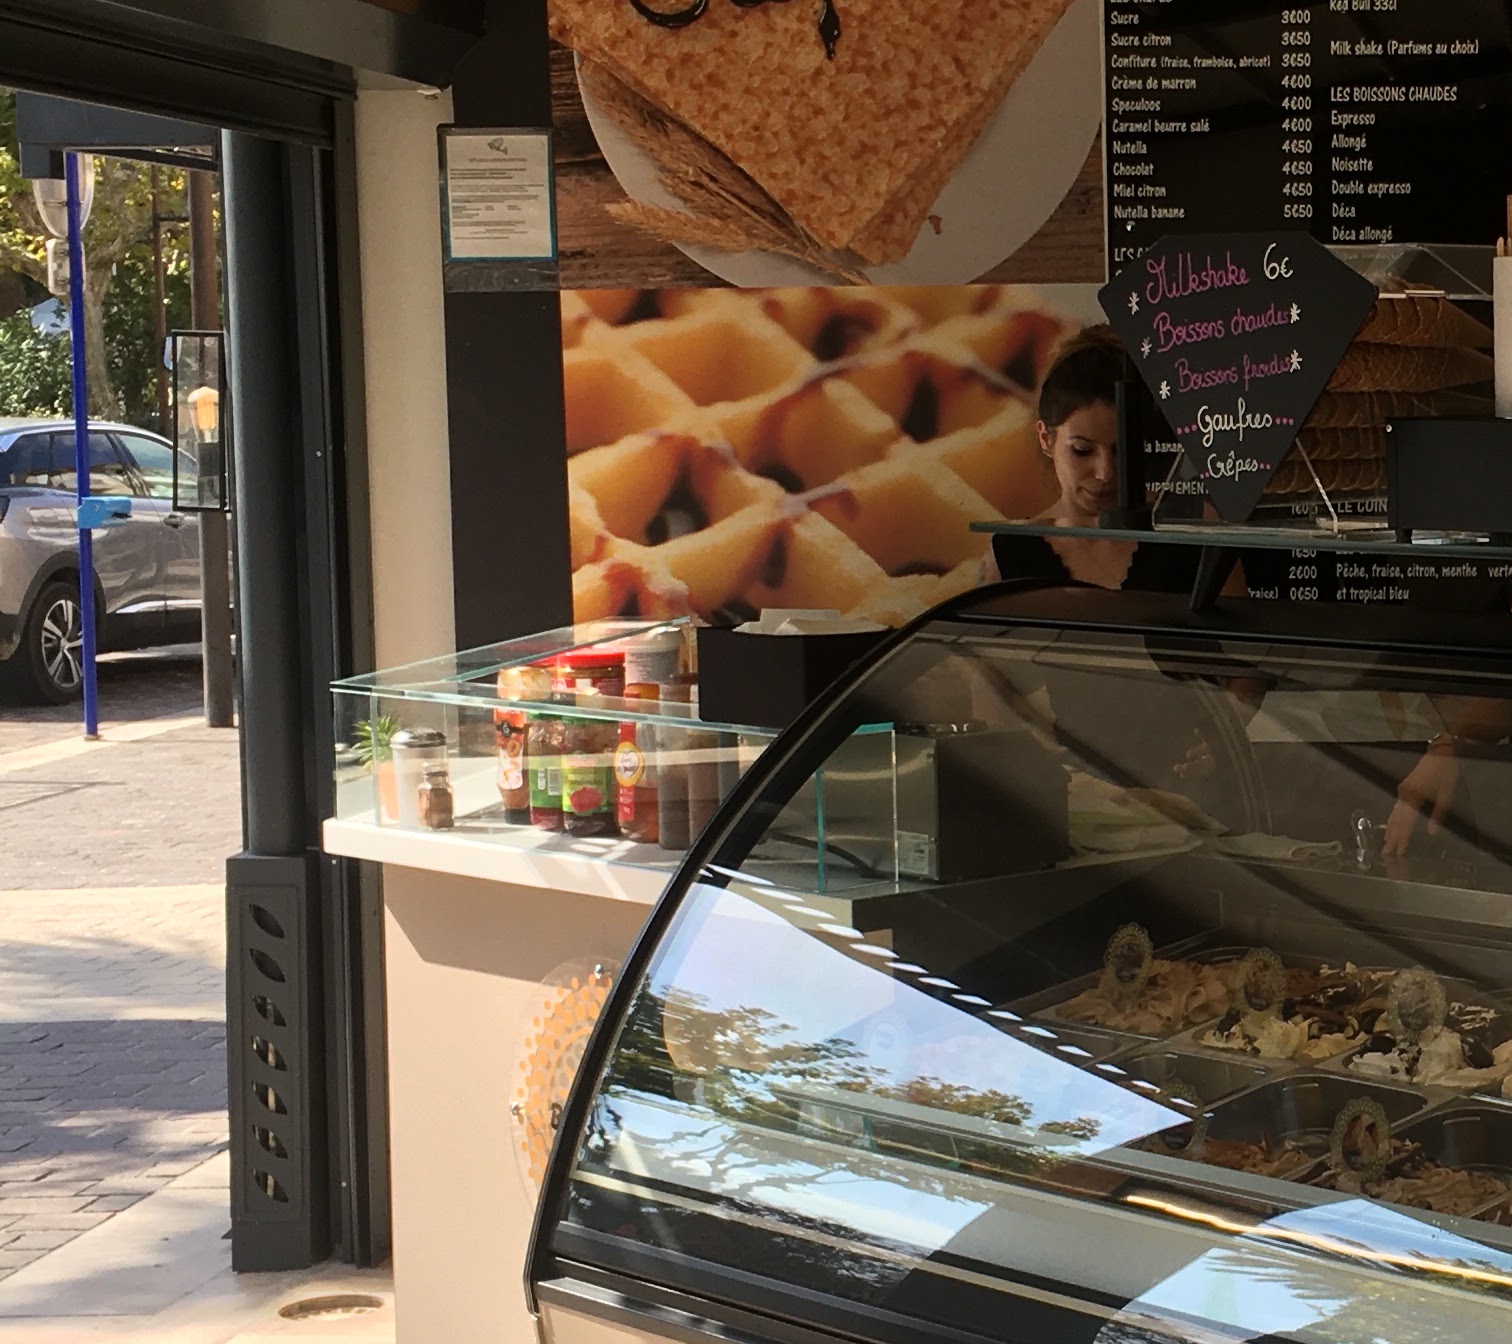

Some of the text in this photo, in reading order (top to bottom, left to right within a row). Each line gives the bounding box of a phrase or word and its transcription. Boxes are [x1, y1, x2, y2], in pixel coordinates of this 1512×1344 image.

[1111, 10, 1310, 24] Sucre 3€00
[1111, 32, 1310, 46] Sucre citron 3€50
[1331, 41, 1351, 55] Milk
[1355, 40, 1383, 55] shake
[1388, 41, 1432, 55] (Parfums
[1436, 44, 1447, 54] au
[1451, 39, 1478, 54] choix)
[1112, 53, 1311, 67] Confiture 3€50
[1112, 75, 1311, 89] Crème de marron 4€00
[1331, 86, 1457, 101] LES BOISSONS CHAUDES
[1112, 97, 1311, 114] Speculoos 4€00
[1113, 118, 1312, 132] Caramel beurre salé 4€00
[1332, 110, 1375, 129] Expresso
[1113, 139, 1312, 154] Nutella 4€50
[1332, 133, 1366, 151] Allongé
[1113, 161, 1312, 175] Chocolat 4€50
[1332, 157, 1373, 171] Noisette
[1114, 183, 1312, 197] Miel citron 4€50
[1332, 180, 1364, 194] Double
[1368, 183, 1411, 198] expresso
[1114, 204, 1312, 218] Nutella banane 5€50
[1333, 203, 1355, 217] Déca
[1333, 226, 1393, 244] Déca allongé
[1146, 242, 1294, 304] Milkshake 6€
[1153, 311, 1225, 353] Boissons
[1175, 358, 1238, 393] Boissons
[1197, 397, 1273, 447] Gaufres
[1207, 450, 1258, 482] Crêpes
[1337, 500, 1353, 513] LE
[1289, 566, 1317, 579] 2€00
[1442, 563, 1477, 577] menthe
[1290, 587, 1318, 600] 0€50
[1337, 588, 1346, 600] et
[1350, 586, 1386, 603] tropical
[1390, 586, 1409, 599] bleu
